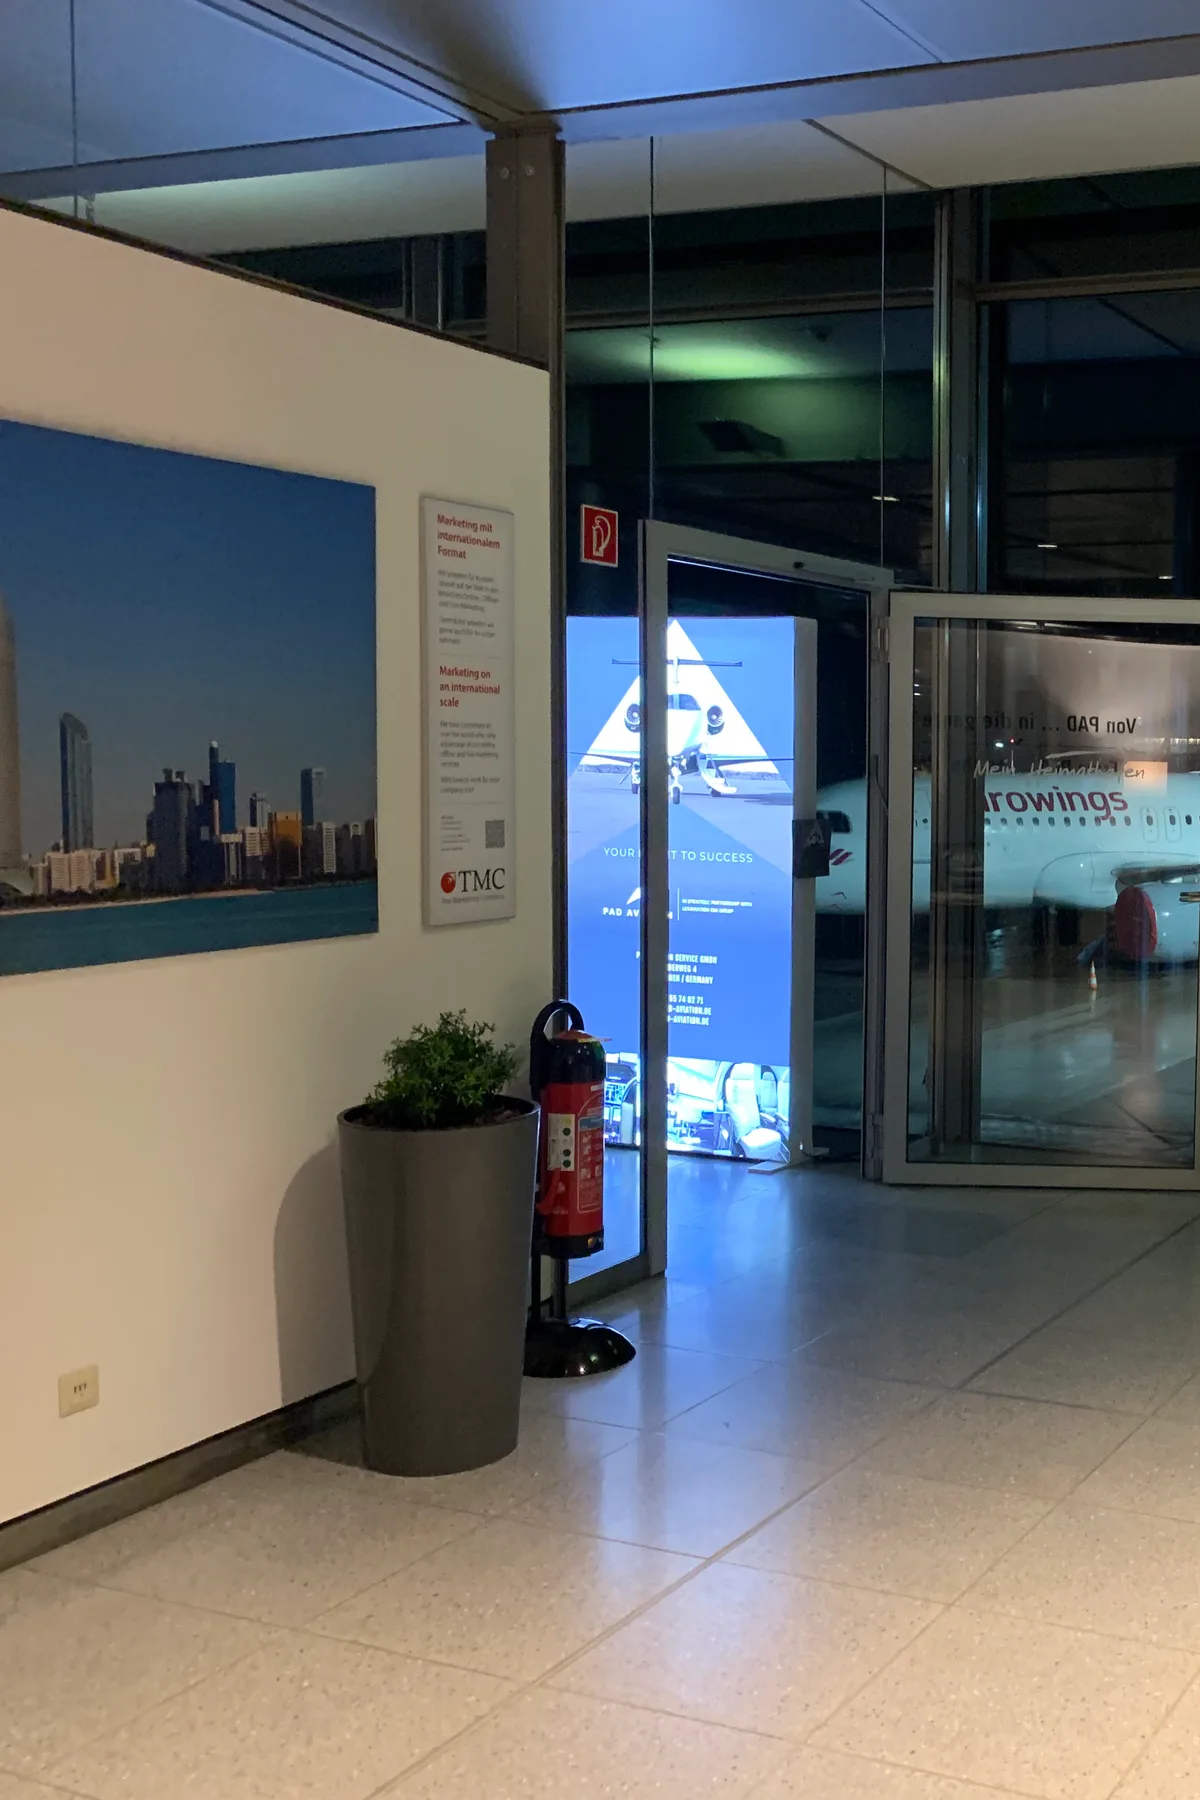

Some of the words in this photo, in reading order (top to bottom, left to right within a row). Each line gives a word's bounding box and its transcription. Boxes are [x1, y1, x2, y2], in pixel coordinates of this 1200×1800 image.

[437, 514, 478, 532] Marketing
[480, 522, 492, 533] mit
[437, 530, 500, 549] internationalem
[437, 545, 466, 559] Format
[439, 665, 479, 680] Marketing
[480, 671, 491, 679] on
[439, 683, 450, 692] an
[451, 681, 500, 695] international
[439, 696, 460, 708] scale
[973, 759, 1017, 779] Mein
[984, 785, 1129, 821] rowings
[603, 847, 636, 858] YOUR
[681, 850, 697, 861] TO
[699, 853, 753, 863] SUCCESS
[458, 868, 505, 893] TMC
[602, 907, 623, 917] PAD
[674, 953, 699, 963] SERVICE
[692, 965, 697, 973] 4
[685, 975, 714, 985] GERMANY
[678, 995, 686, 1003] 74
[696, 996, 704, 1005] 71
